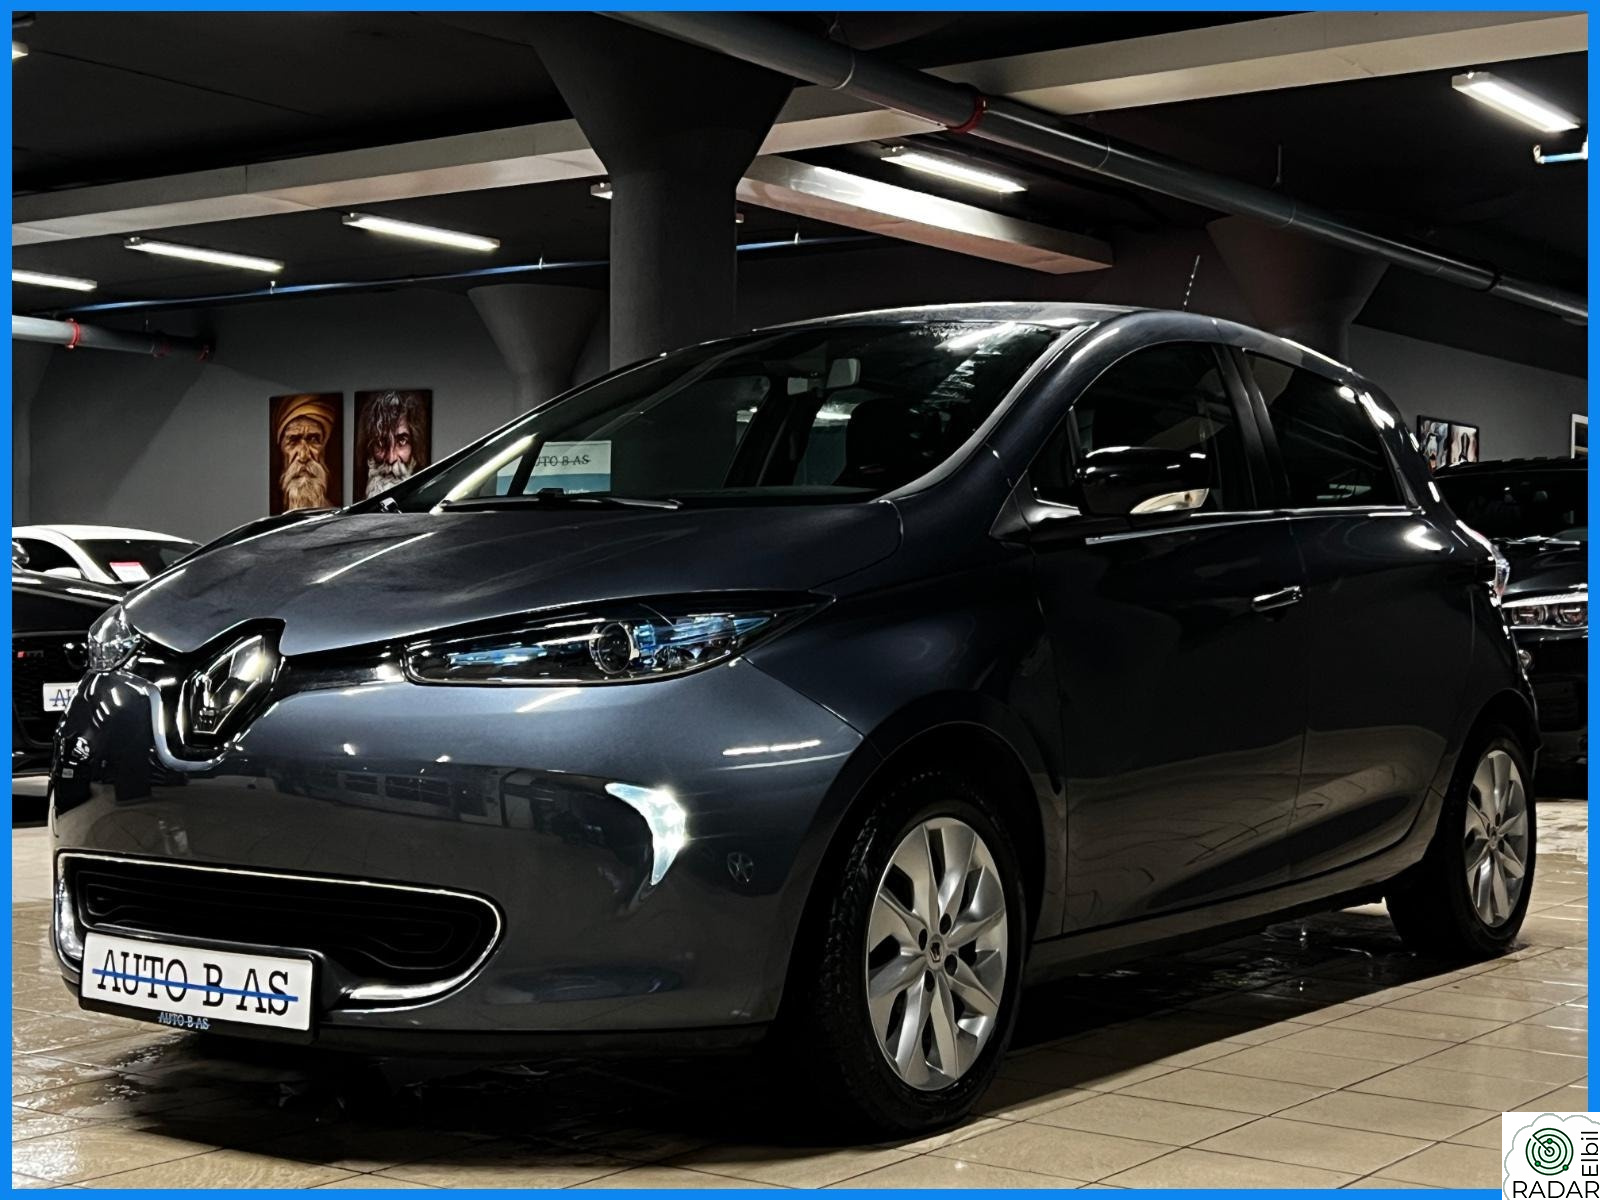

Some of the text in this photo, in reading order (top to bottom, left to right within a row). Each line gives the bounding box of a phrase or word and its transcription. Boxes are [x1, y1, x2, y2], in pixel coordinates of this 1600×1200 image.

[562, 456, 569, 466] B
[573, 454, 590, 465] AS
[98, 949, 288, 1016] AUTO B AS
[159, 1011, 209, 1030] AUTO B AS
